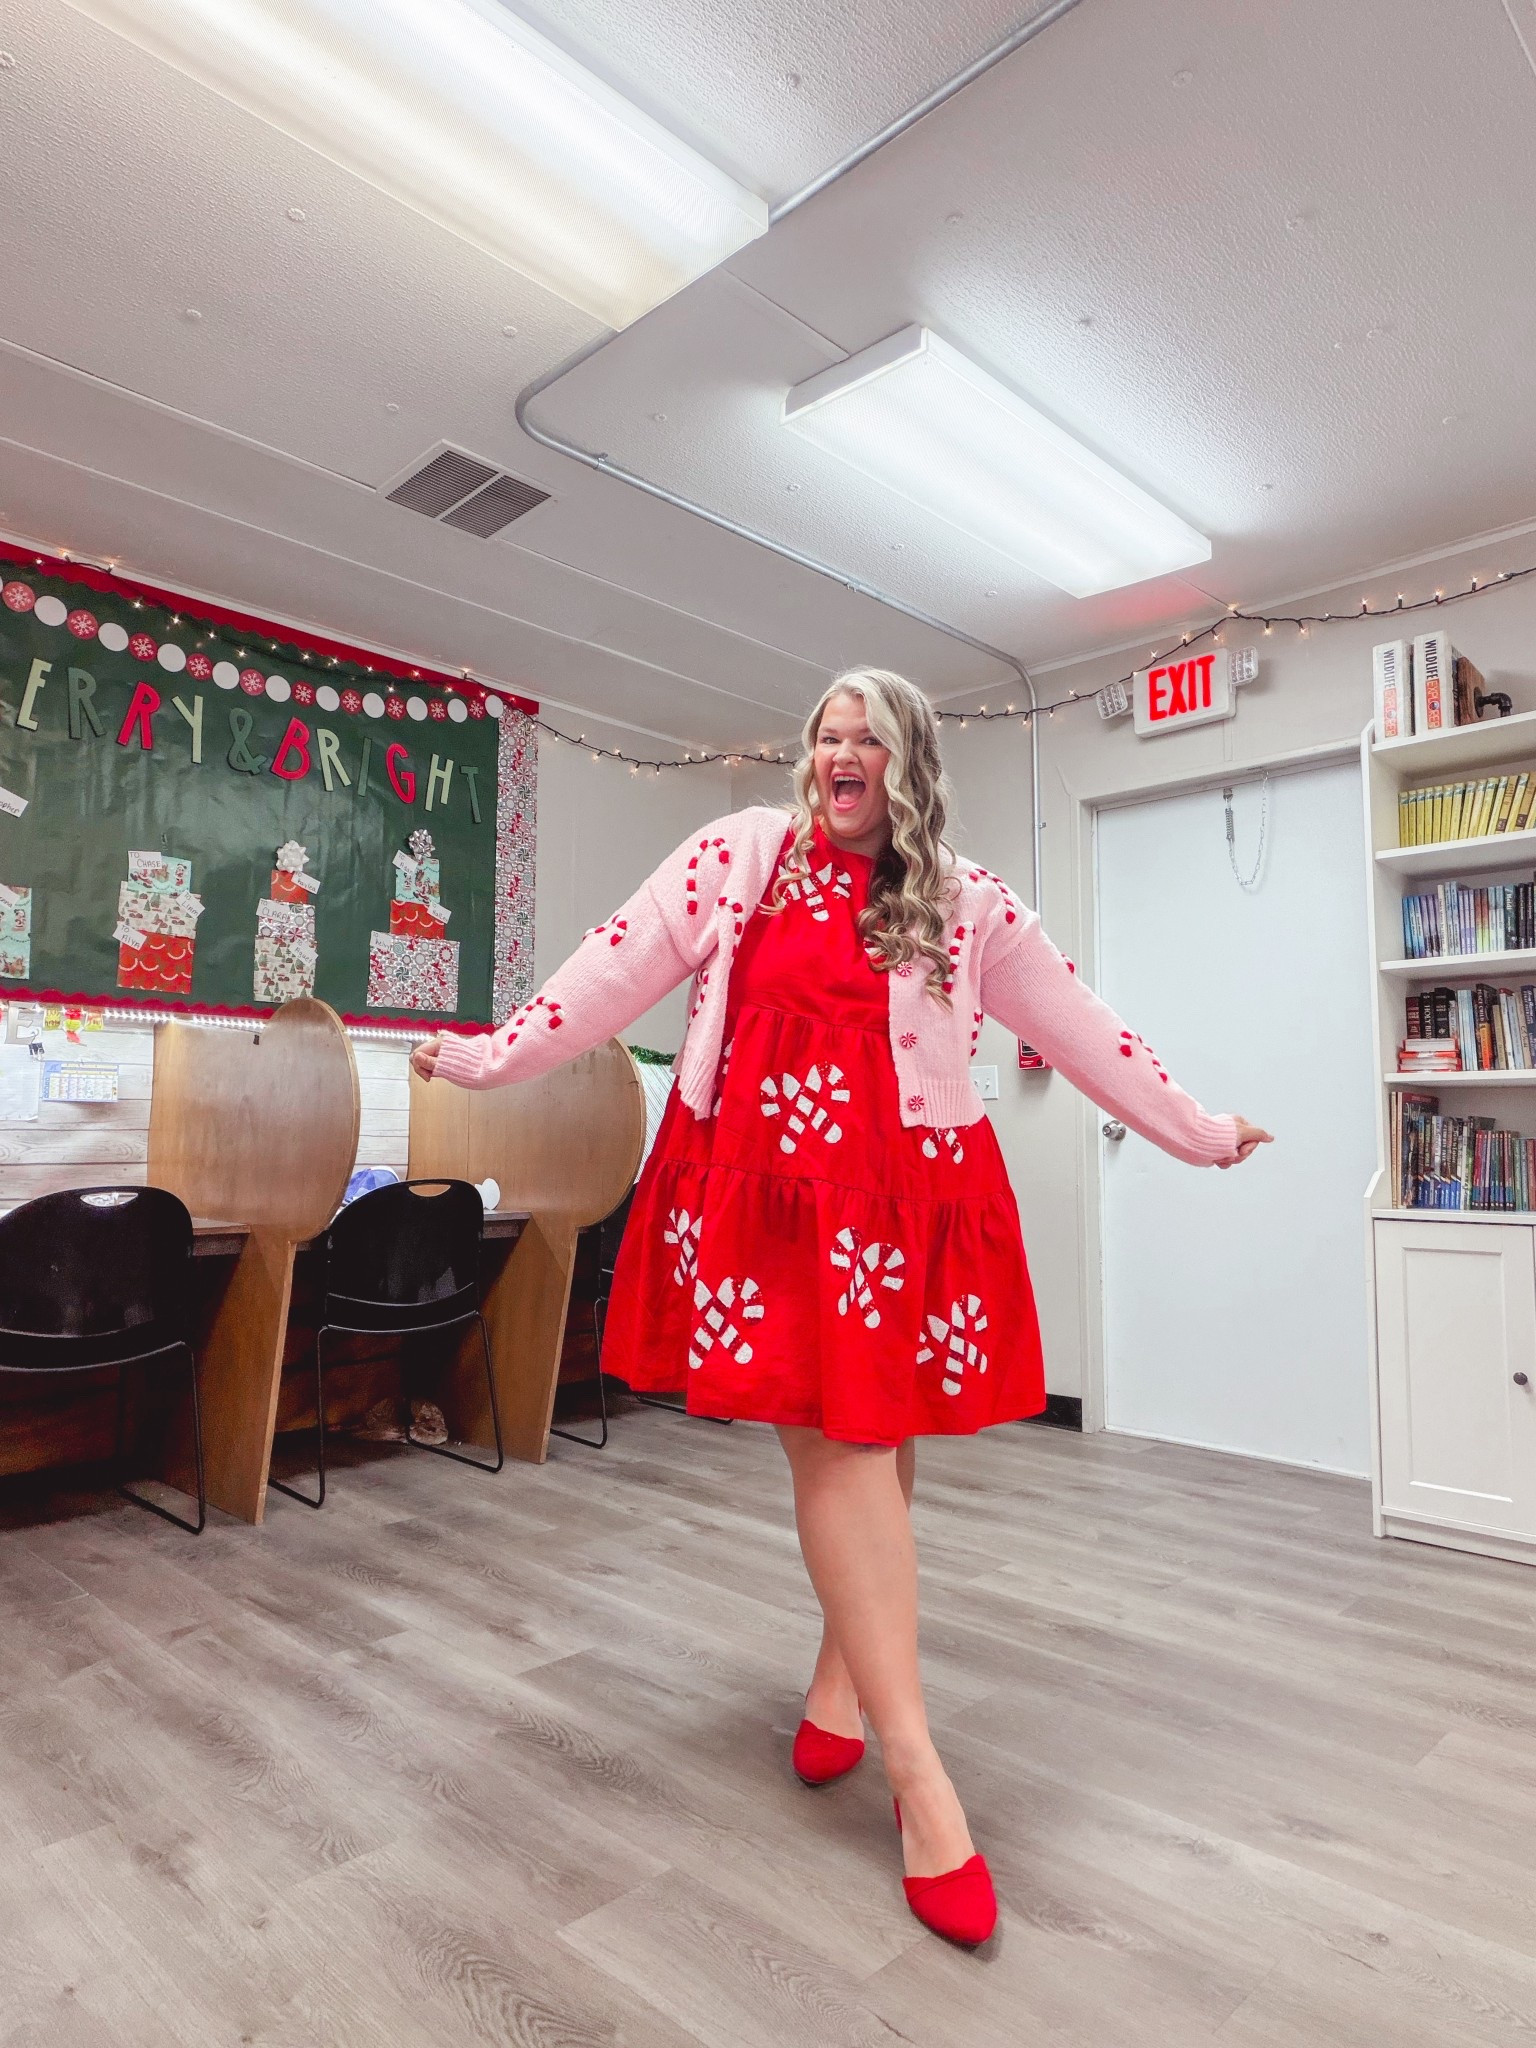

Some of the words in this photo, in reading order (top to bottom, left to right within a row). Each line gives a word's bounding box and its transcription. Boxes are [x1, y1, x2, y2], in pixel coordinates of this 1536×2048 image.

[1383, 648, 1396, 689] WILDLIFE
[1425, 639, 1439, 680] WILDLIFE
[1148, 654, 1216, 721] EXIT
[1426, 680, 1441, 729] EXPLORER
[16, 658, 204, 764] ERRY
[228, 707, 267, 775] &
[270, 717, 482, 824] BRIGHT
[136, 858, 161, 868] CHASE
[121, 925, 130, 933] TO
[262, 906, 289, 920] CLARA
[1424, 1004, 1432, 1023] HOLY
